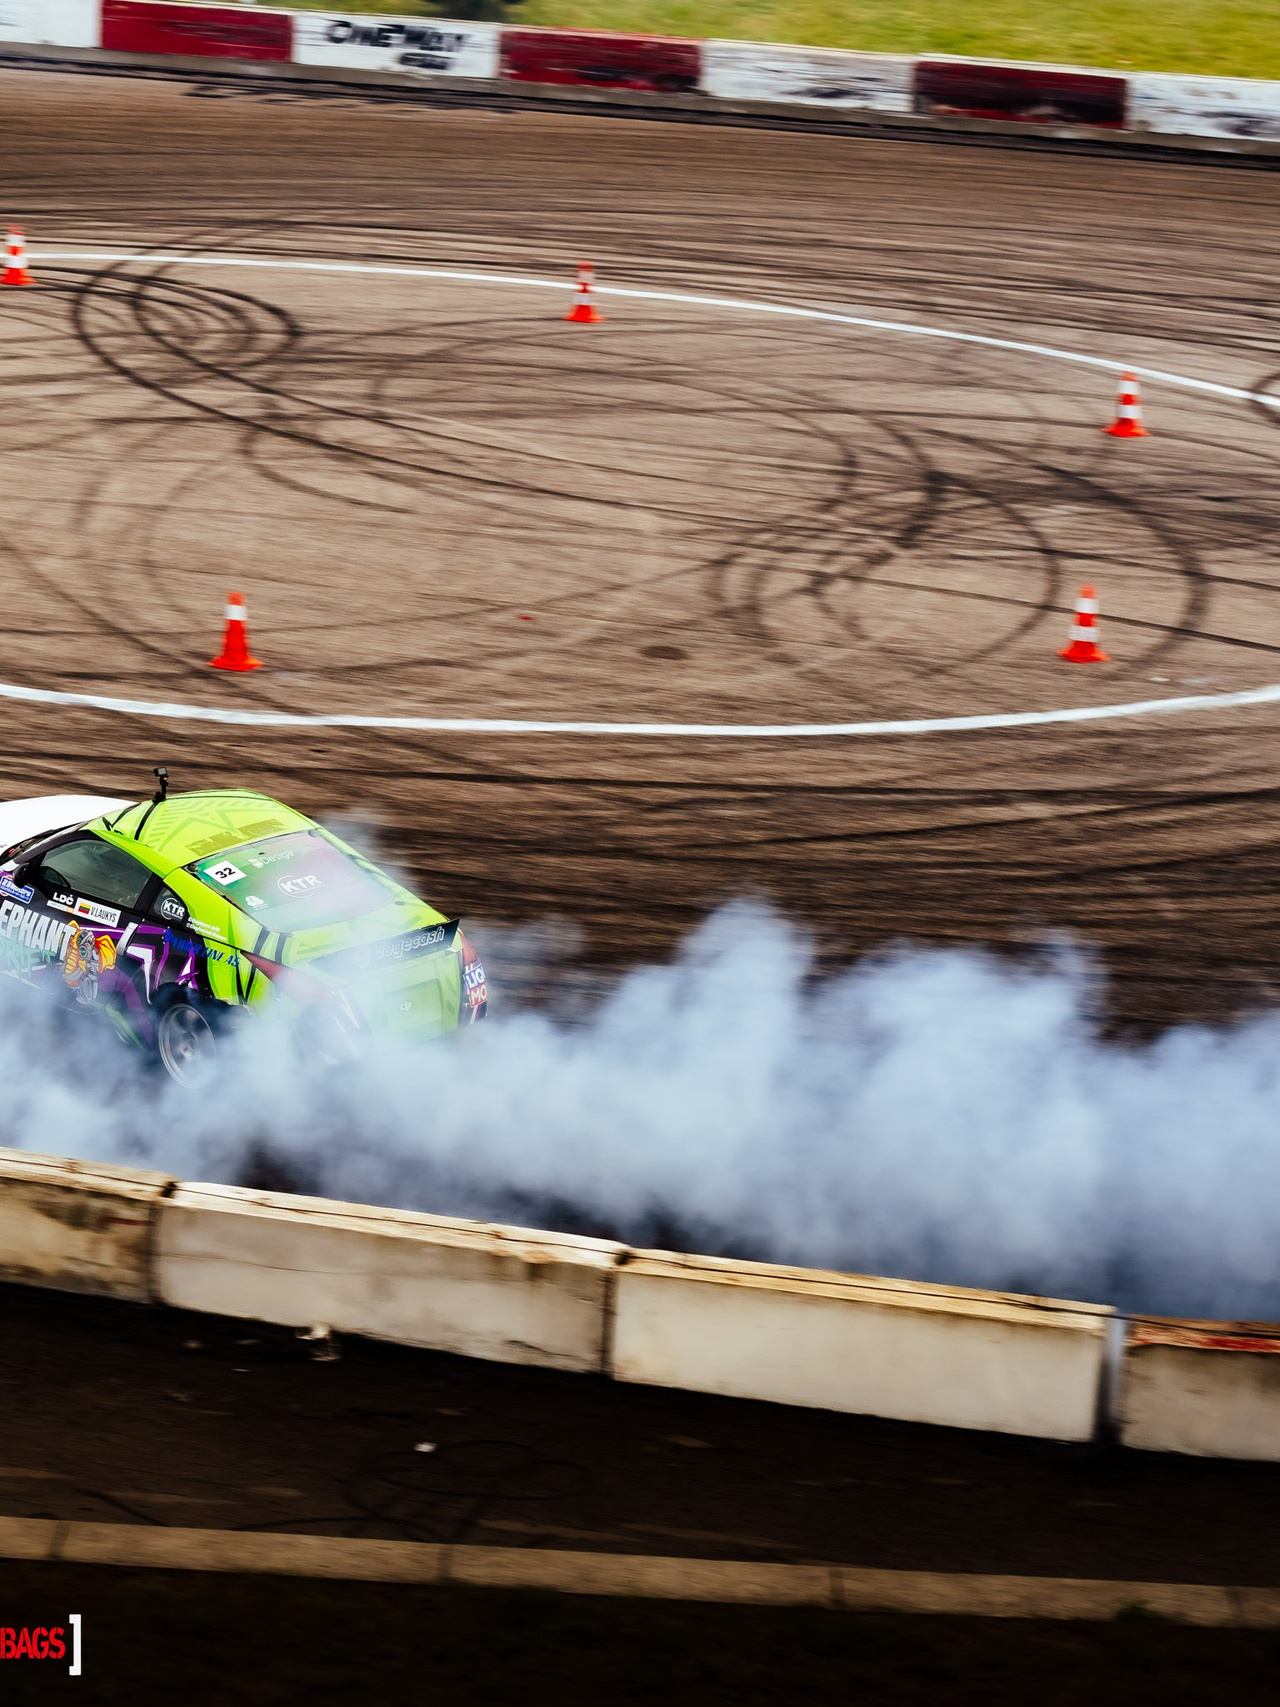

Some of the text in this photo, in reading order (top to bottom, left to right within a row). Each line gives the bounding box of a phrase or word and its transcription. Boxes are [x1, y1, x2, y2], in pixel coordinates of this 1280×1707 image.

[215, 867, 236, 879] 32
[280, 875, 322, 894] KTR
[163, 901, 185, 917] KTR
[375, 926, 446, 959] dogecash
[467, 967, 486, 988] LIQ
[470, 985, 487, 1006] MO
